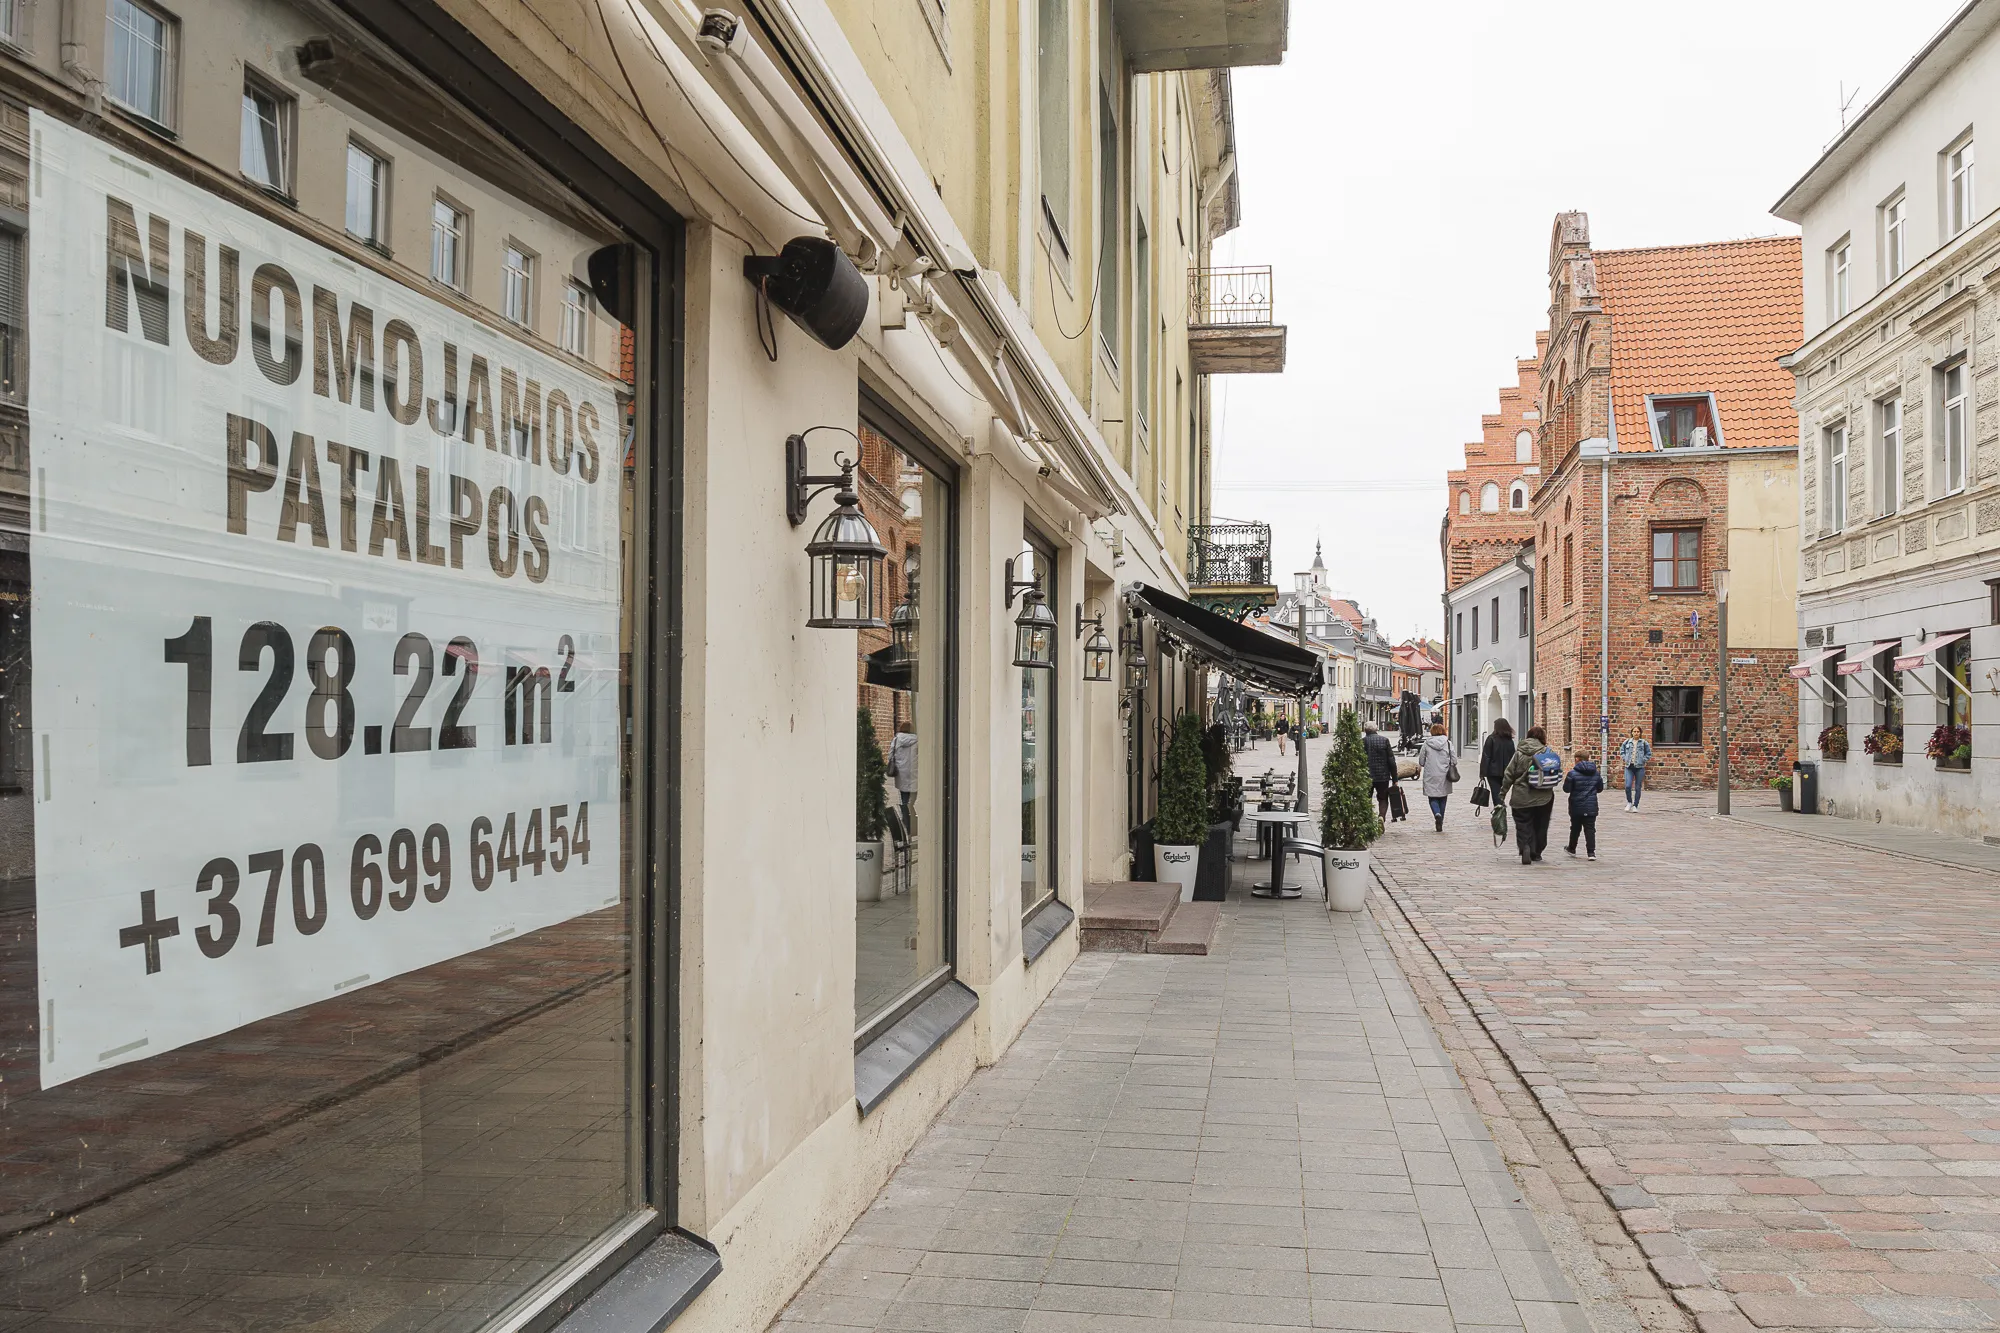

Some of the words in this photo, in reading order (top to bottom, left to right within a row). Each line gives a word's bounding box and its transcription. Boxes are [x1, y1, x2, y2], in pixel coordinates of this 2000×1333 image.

[106, 195, 601, 485] NUOMOJAMOS
[226, 412, 550, 584] PATALPOS
[164, 615, 480, 767] 128.22
[119, 843, 328, 975] +370
[350, 822, 451, 921] 699
[470, 801, 591, 893] 64454
[1163, 851, 1191, 864] Carlsberg
[1331, 857, 1360, 870] Carlsberg
